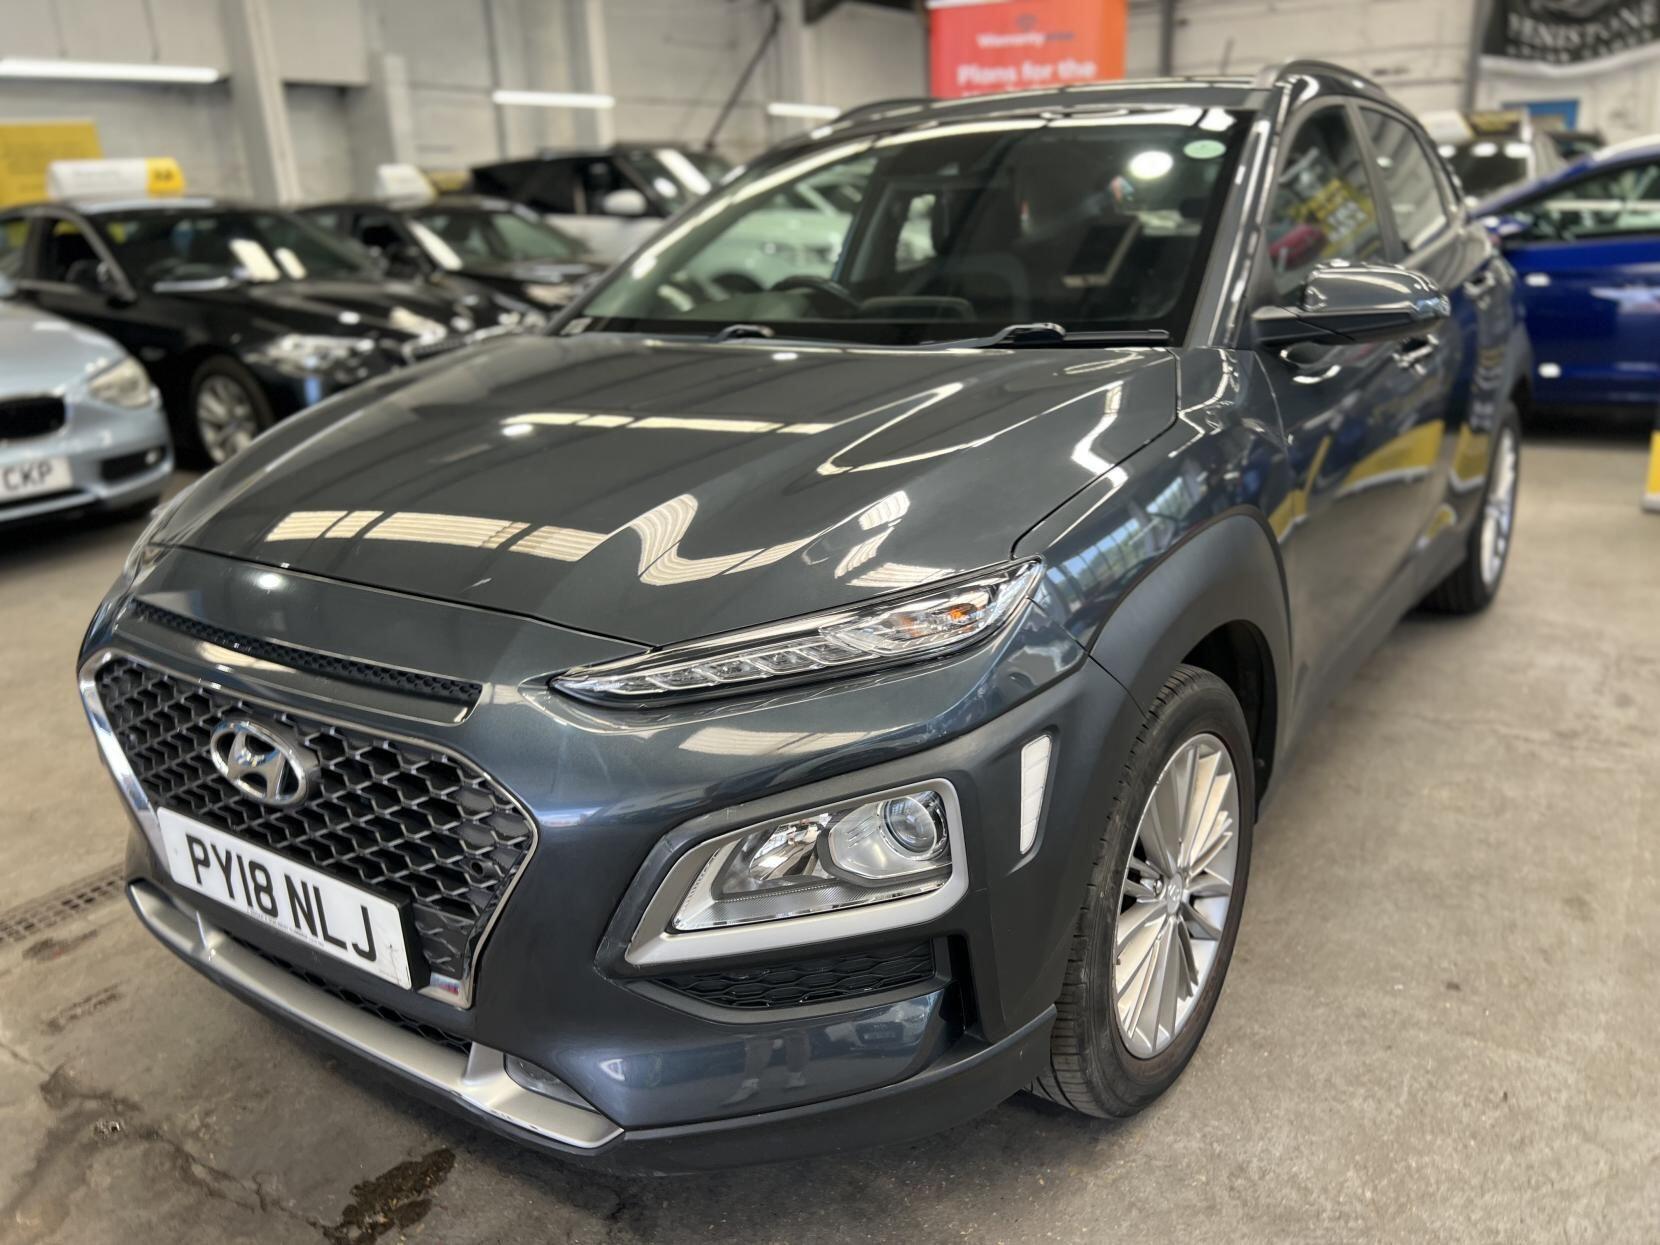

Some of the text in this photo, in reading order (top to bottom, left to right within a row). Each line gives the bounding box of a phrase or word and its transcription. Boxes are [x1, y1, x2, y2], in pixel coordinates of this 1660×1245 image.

[957, 58, 1096, 86] Plans for the
[2, 459, 53, 491] CKP
[186, 832, 279, 919] PY18
[284, 872, 377, 963] NLJ
